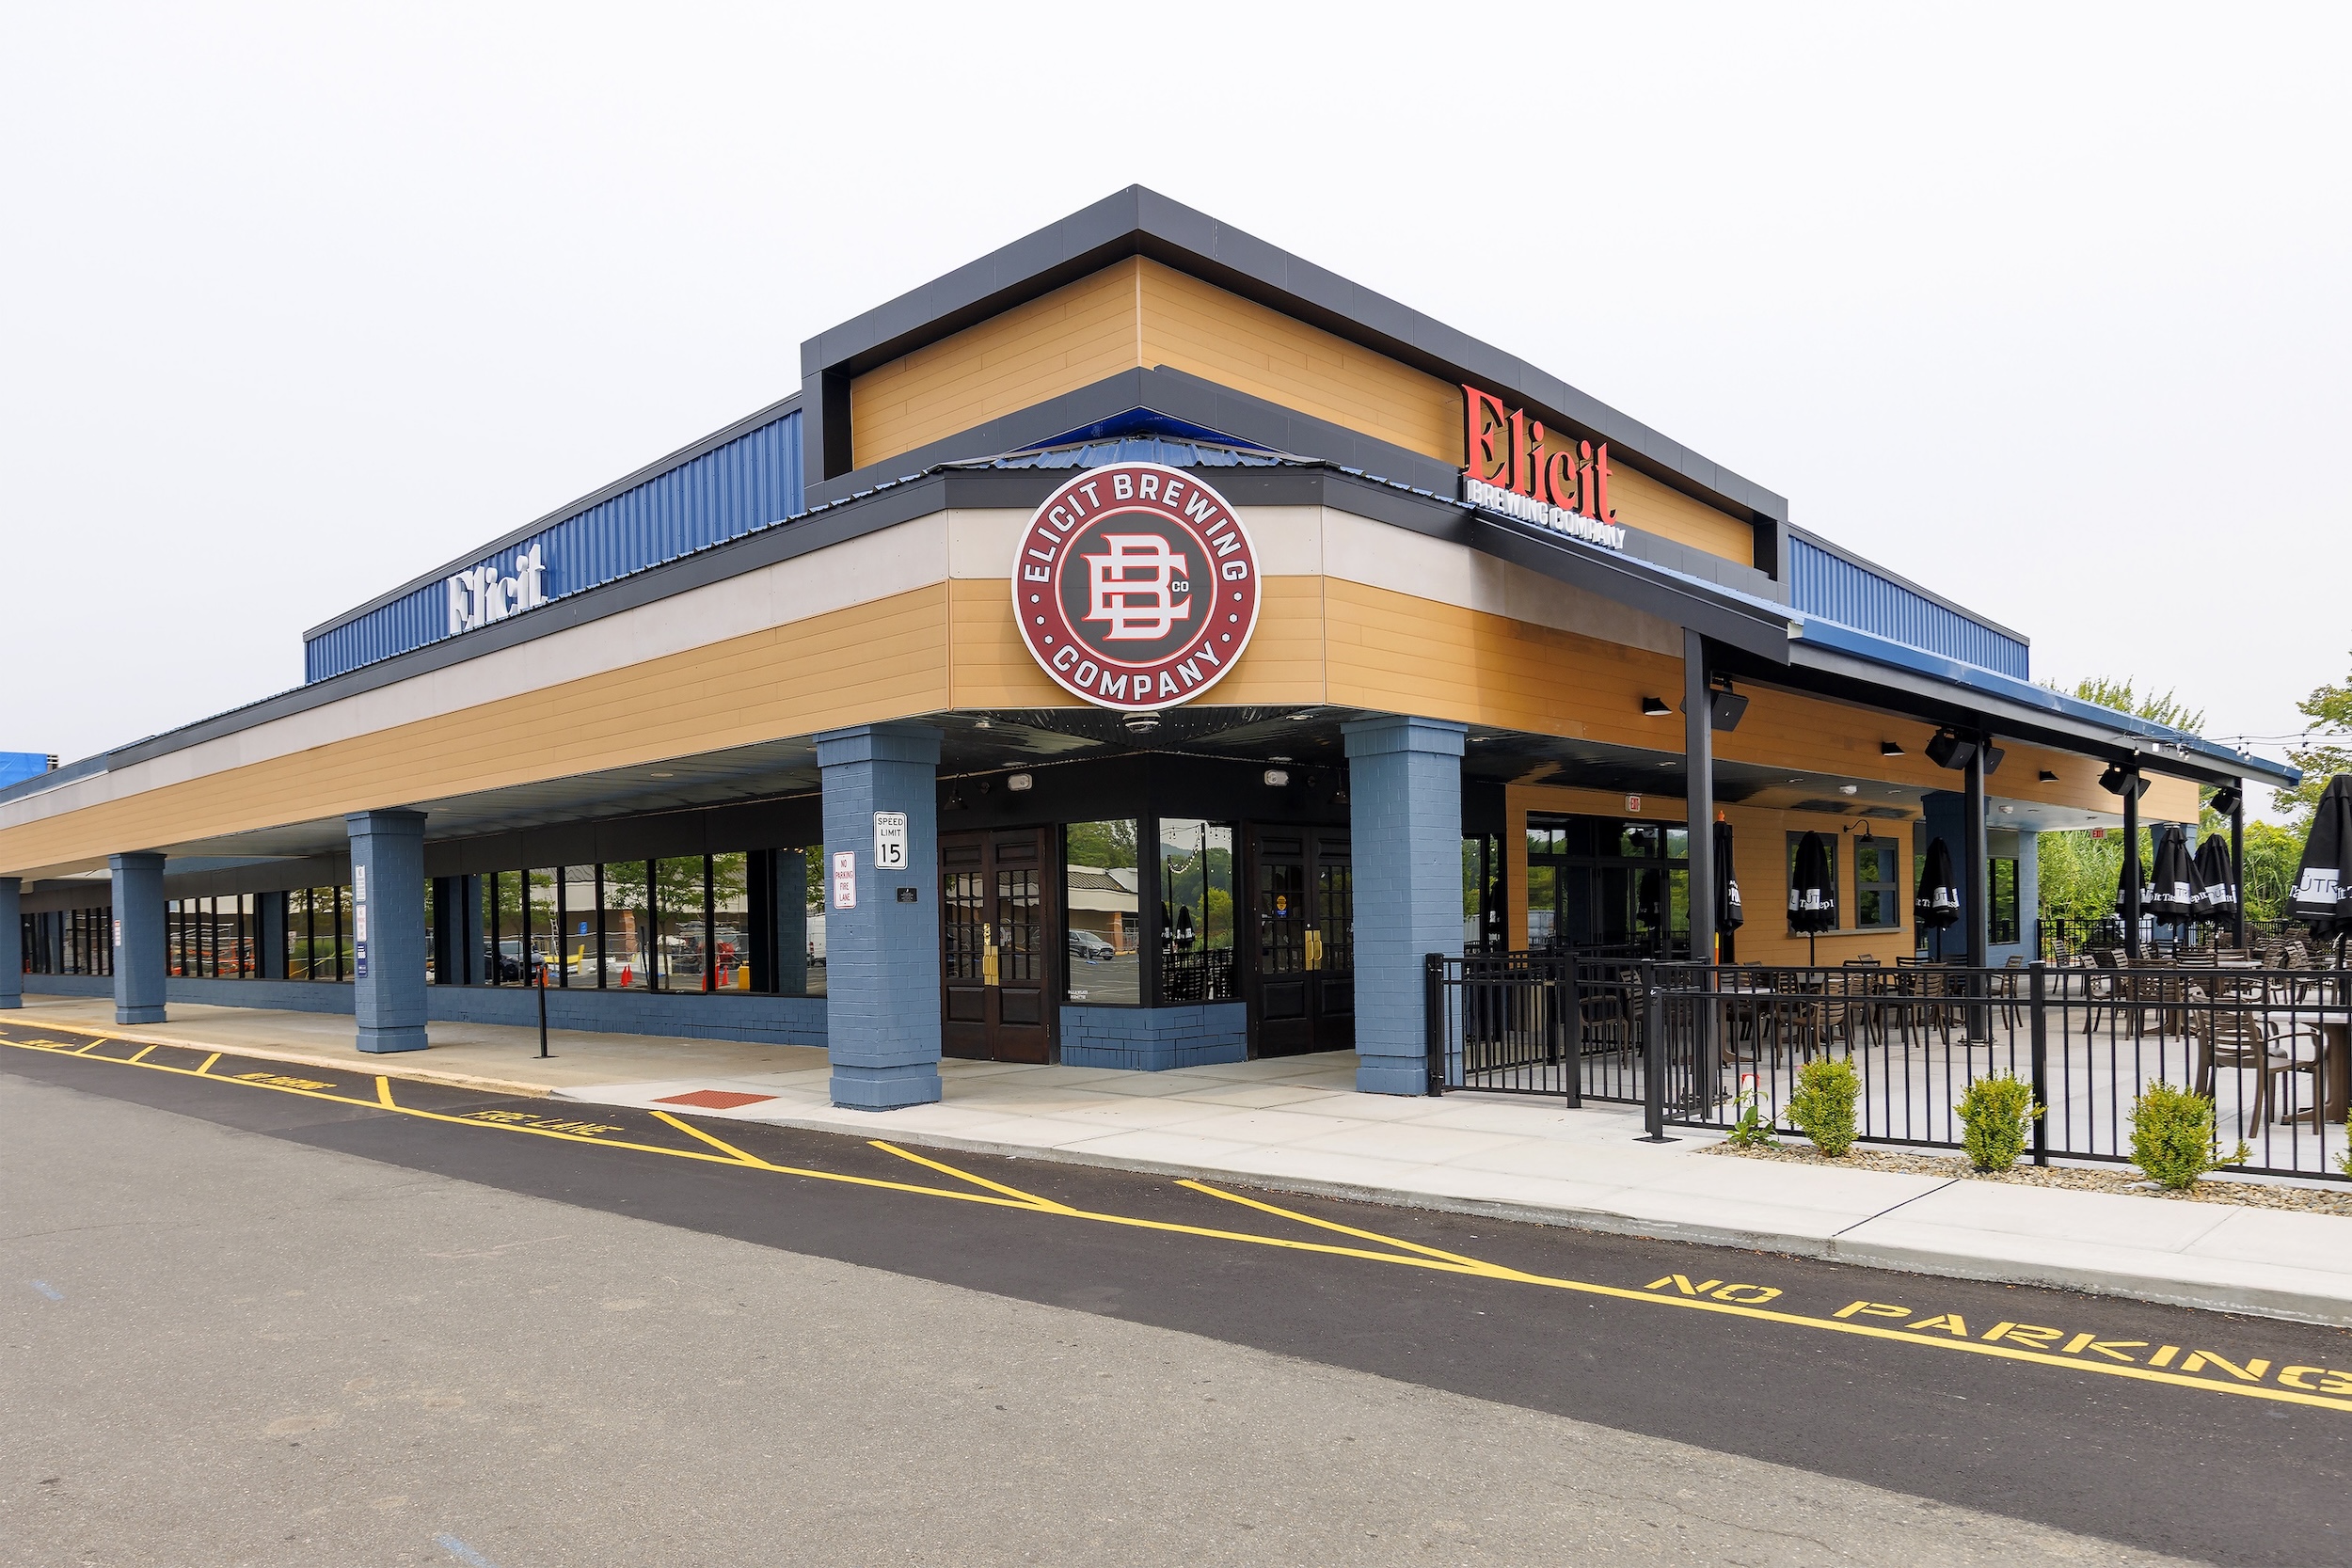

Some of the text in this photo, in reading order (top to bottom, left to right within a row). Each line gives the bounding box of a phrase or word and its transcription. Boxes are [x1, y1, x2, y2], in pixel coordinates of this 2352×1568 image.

[1460, 383, 1617, 526] Elicit
[1467, 479, 1627, 550] BREWING COMPANY
[1024, 473, 1248, 583] ELICIT BREWING
[446, 543, 548, 636] Elicit
[1171, 580, 1189, 593] CO
[1052, 640, 1221, 701] COMPANY
[878, 817, 903, 826] SPEED
[882, 843, 900, 863] 15
[840, 859, 848, 868] NO
[835, 871, 854, 879] PARKING
[839, 882, 850, 891] FIRE
[839, 893, 850, 902] LANE
[1645, 1274, 2352, 1394] NO PARKING
